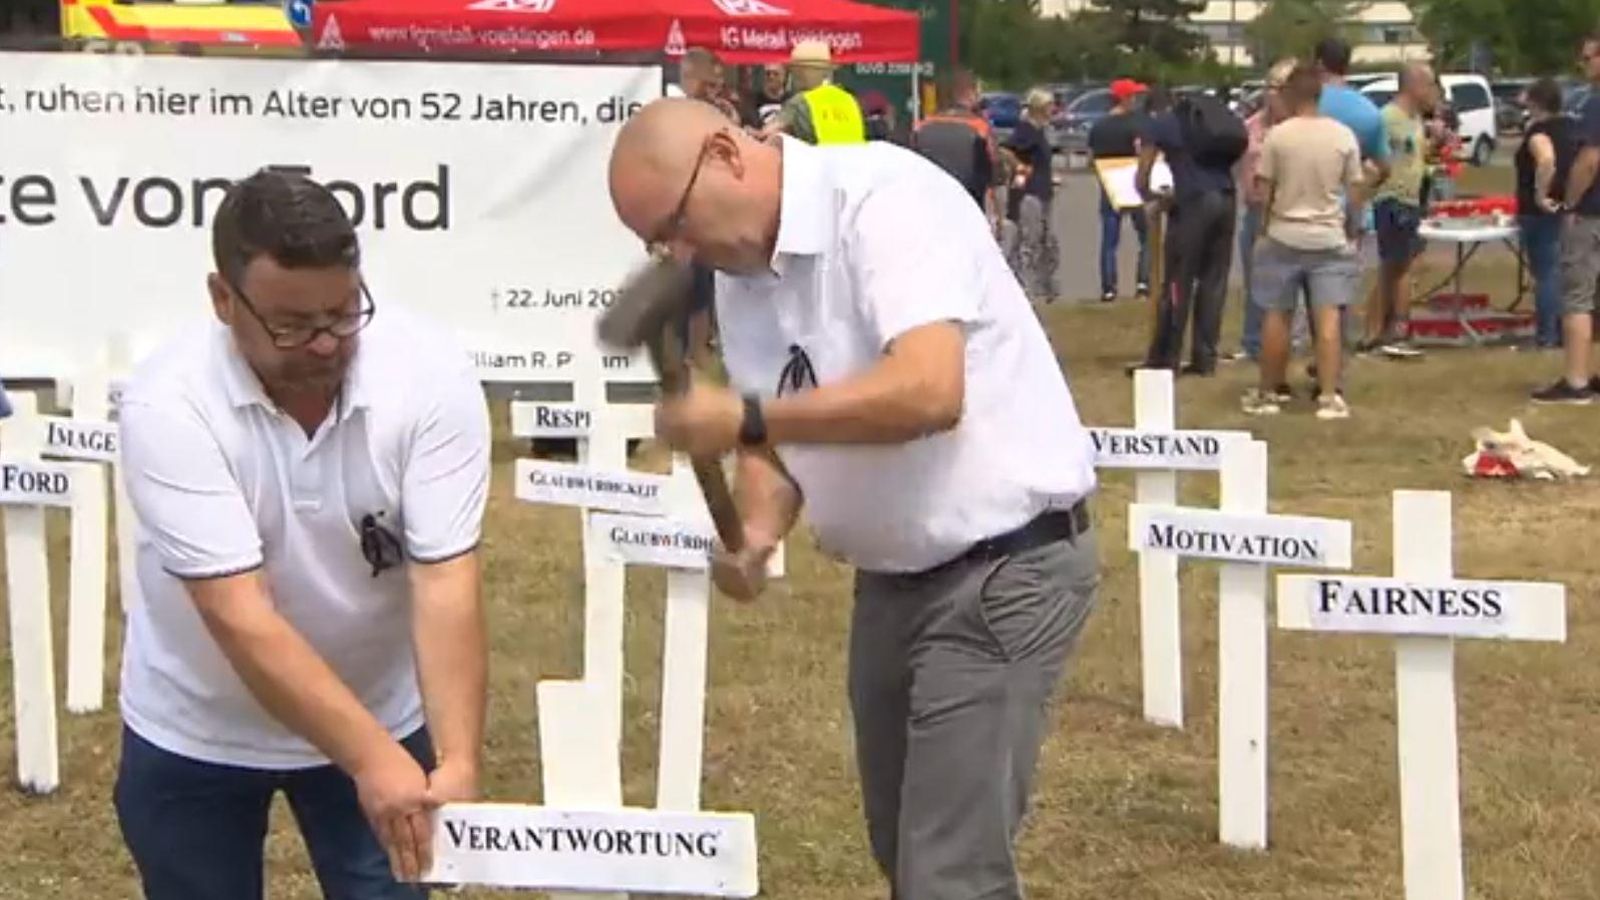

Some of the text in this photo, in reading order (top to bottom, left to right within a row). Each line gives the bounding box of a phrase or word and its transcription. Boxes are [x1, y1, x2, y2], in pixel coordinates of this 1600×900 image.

[24, 84, 125, 116] ruhen
[135, 84, 199, 116] hier
[210, 88, 253, 117] im
[262, 90, 341, 118] Alter
[351, 96, 411, 120] von
[420, 93, 461, 121] 52
[469, 95, 588, 124] Jahren,
[507, 289, 539, 307] 22.
[543, 289, 583, 307] Juni
[47, 422, 116, 452] IMAGE
[1091, 430, 1220, 456] VERSTAND
[2, 465, 70, 494] FORD
[1148, 523, 1320, 561] MOTIVATION
[1318, 580, 1503, 619] FAIRNESS
[445, 819, 718, 857] VERANTWORTUNG
